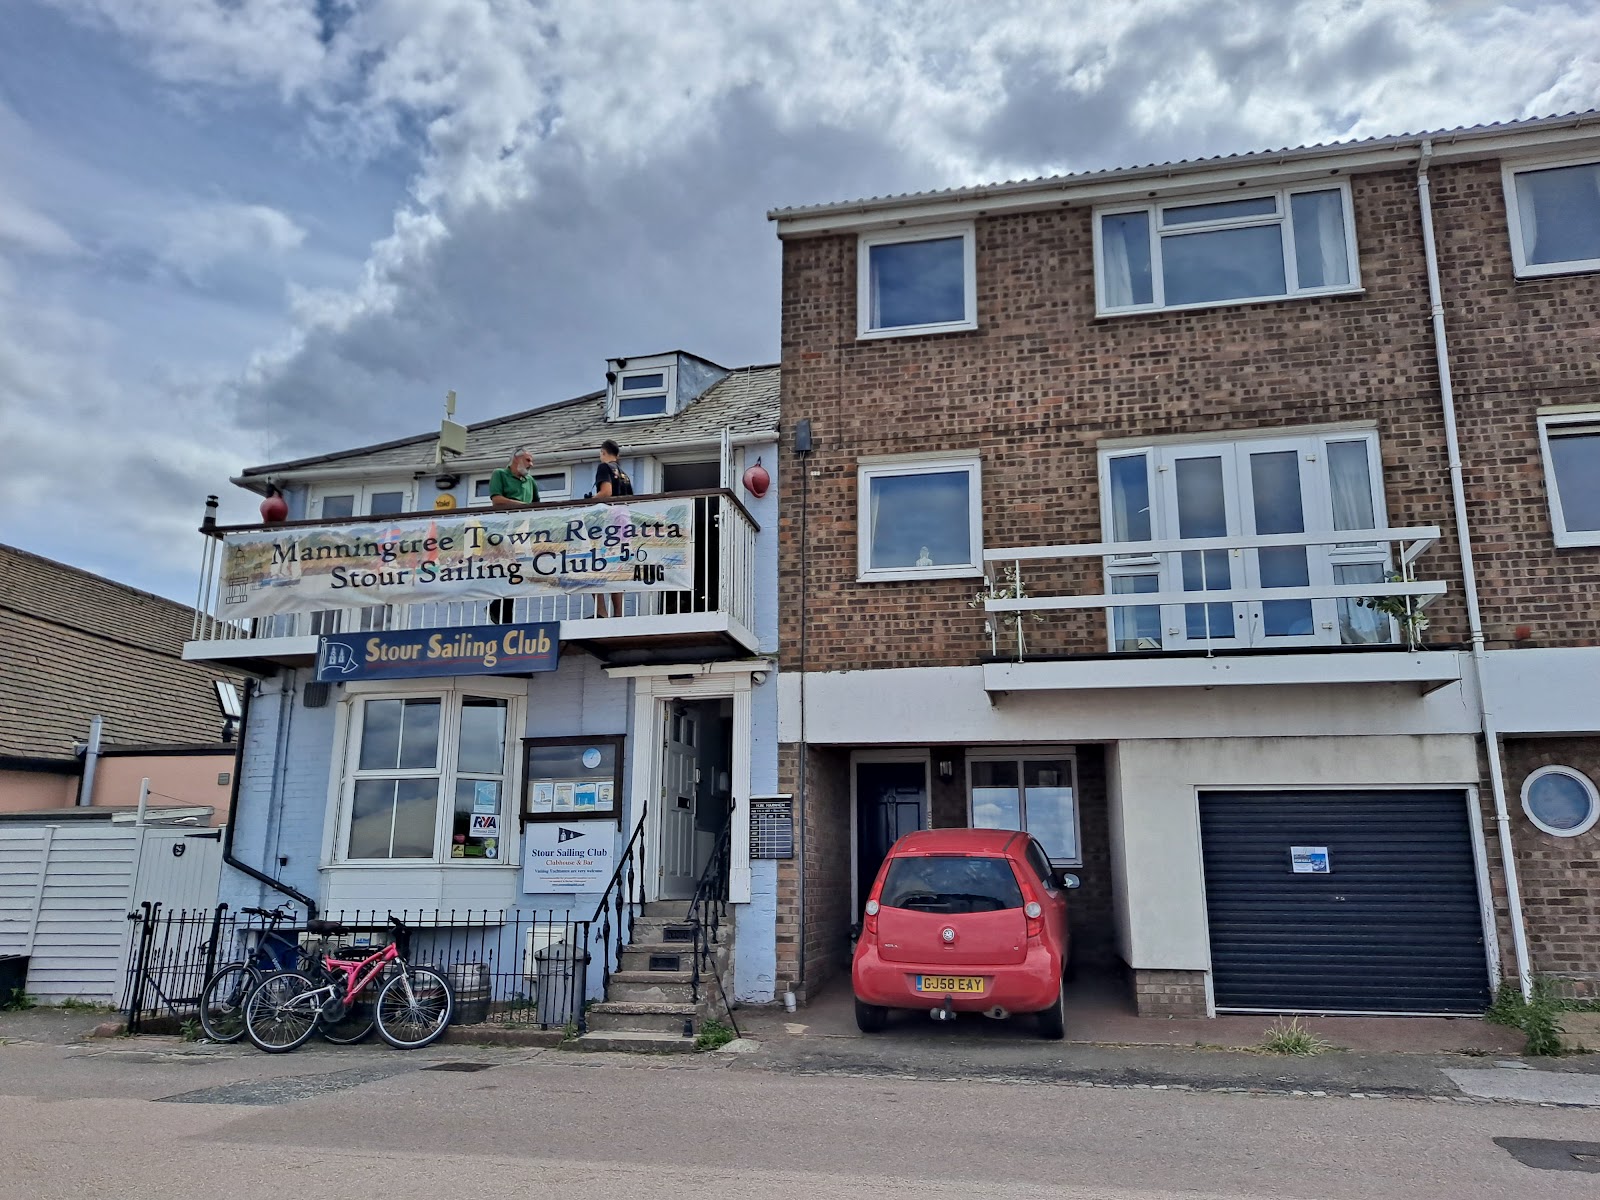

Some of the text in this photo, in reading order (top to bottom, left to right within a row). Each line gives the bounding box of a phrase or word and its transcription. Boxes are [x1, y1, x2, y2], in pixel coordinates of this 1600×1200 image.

[271, 518, 683, 565] Manningtree Town Regatta
[330, 549, 608, 589] Stour Sailing Club
[633, 564, 665, 585] AUG
[365, 629, 551, 667] Stour Sailing Club
[473, 815, 497, 828] RYA
[531, 848, 607, 858] Stour Sailing Club
[924, 977, 982, 991] GJ58 EAY
